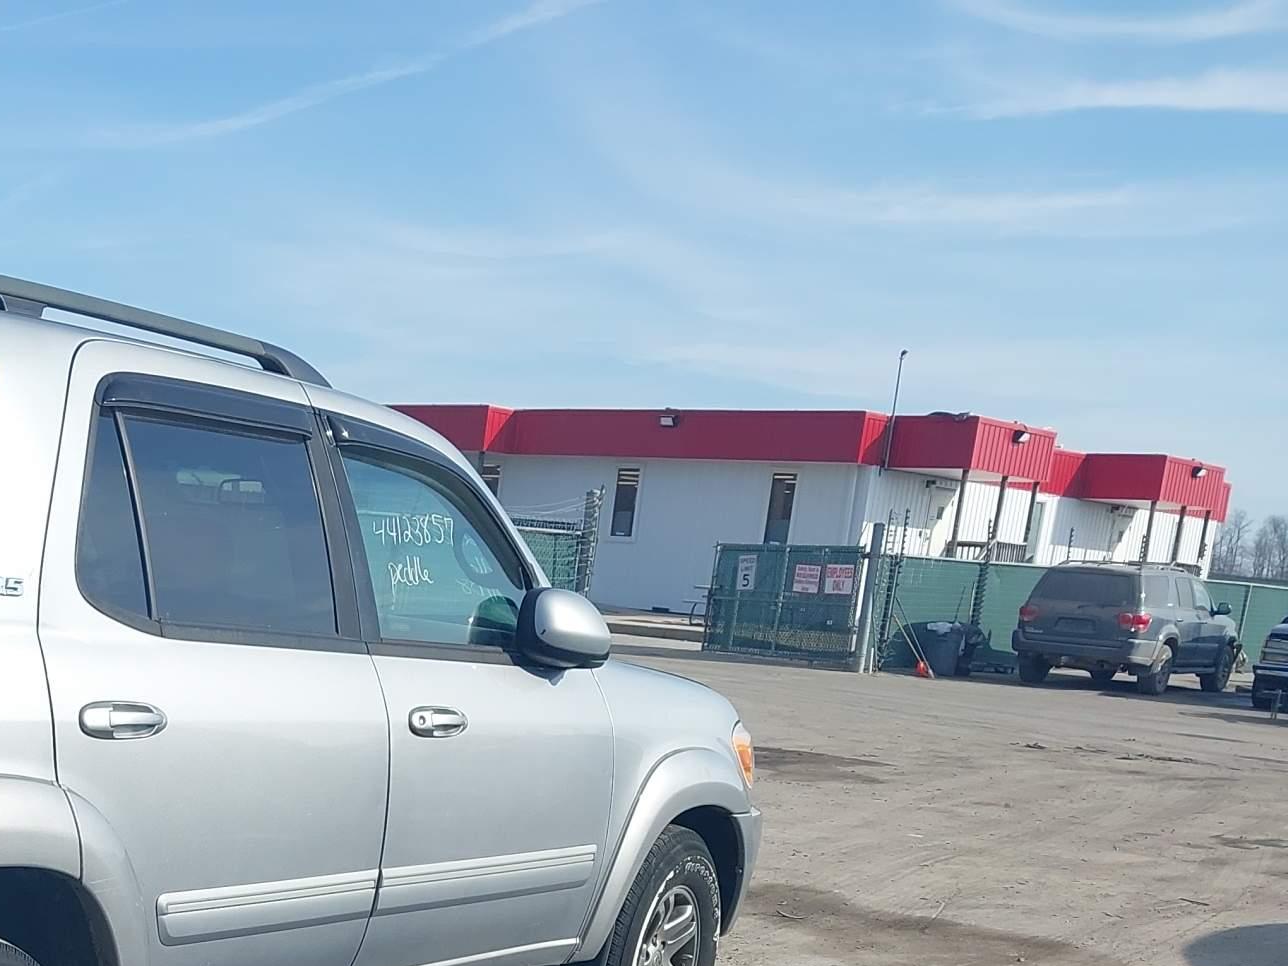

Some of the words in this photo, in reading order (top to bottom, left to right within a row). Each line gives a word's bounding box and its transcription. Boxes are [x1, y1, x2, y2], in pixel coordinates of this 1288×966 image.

[372, 512, 454, 547] 44123857
[826, 566, 854, 579] EMPLOYEES
[742, 573, 750, 587] 5
[832, 579, 845, 592] ONLY
